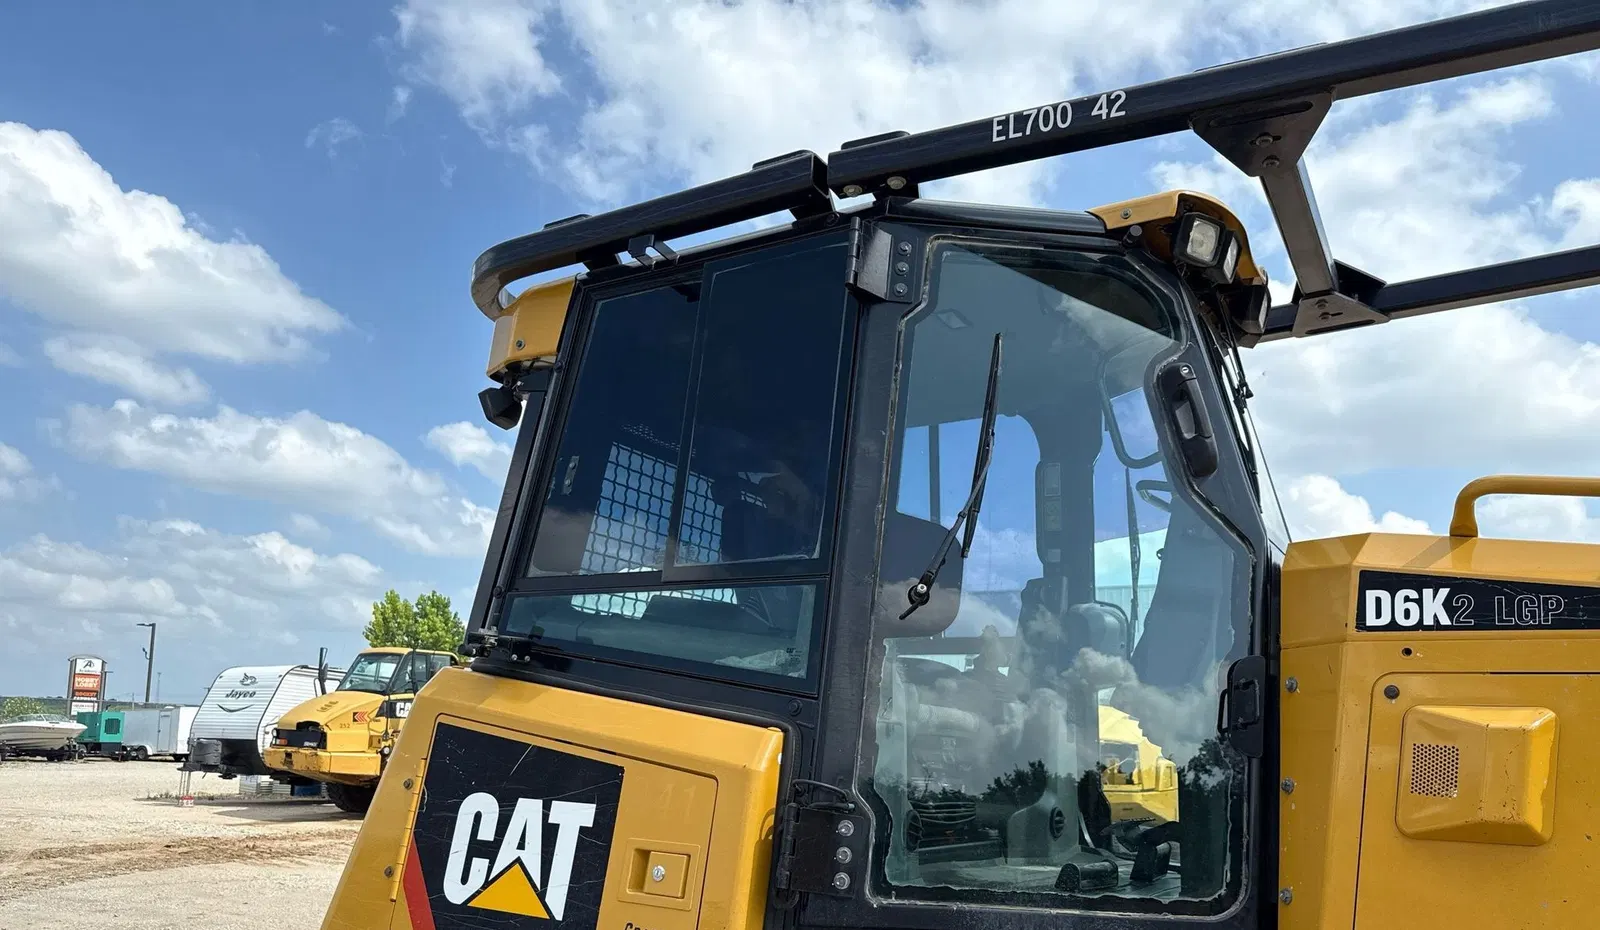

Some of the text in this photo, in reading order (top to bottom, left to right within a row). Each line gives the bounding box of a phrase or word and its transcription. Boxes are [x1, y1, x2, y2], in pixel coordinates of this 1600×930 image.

[992, 90, 1127, 143] EL700 42
[1365, 587, 1565, 627] D6K2 LGP
[225, 690, 256, 700] Jayco
[396, 702, 412, 717] CA
[443, 792, 598, 922] CAT
